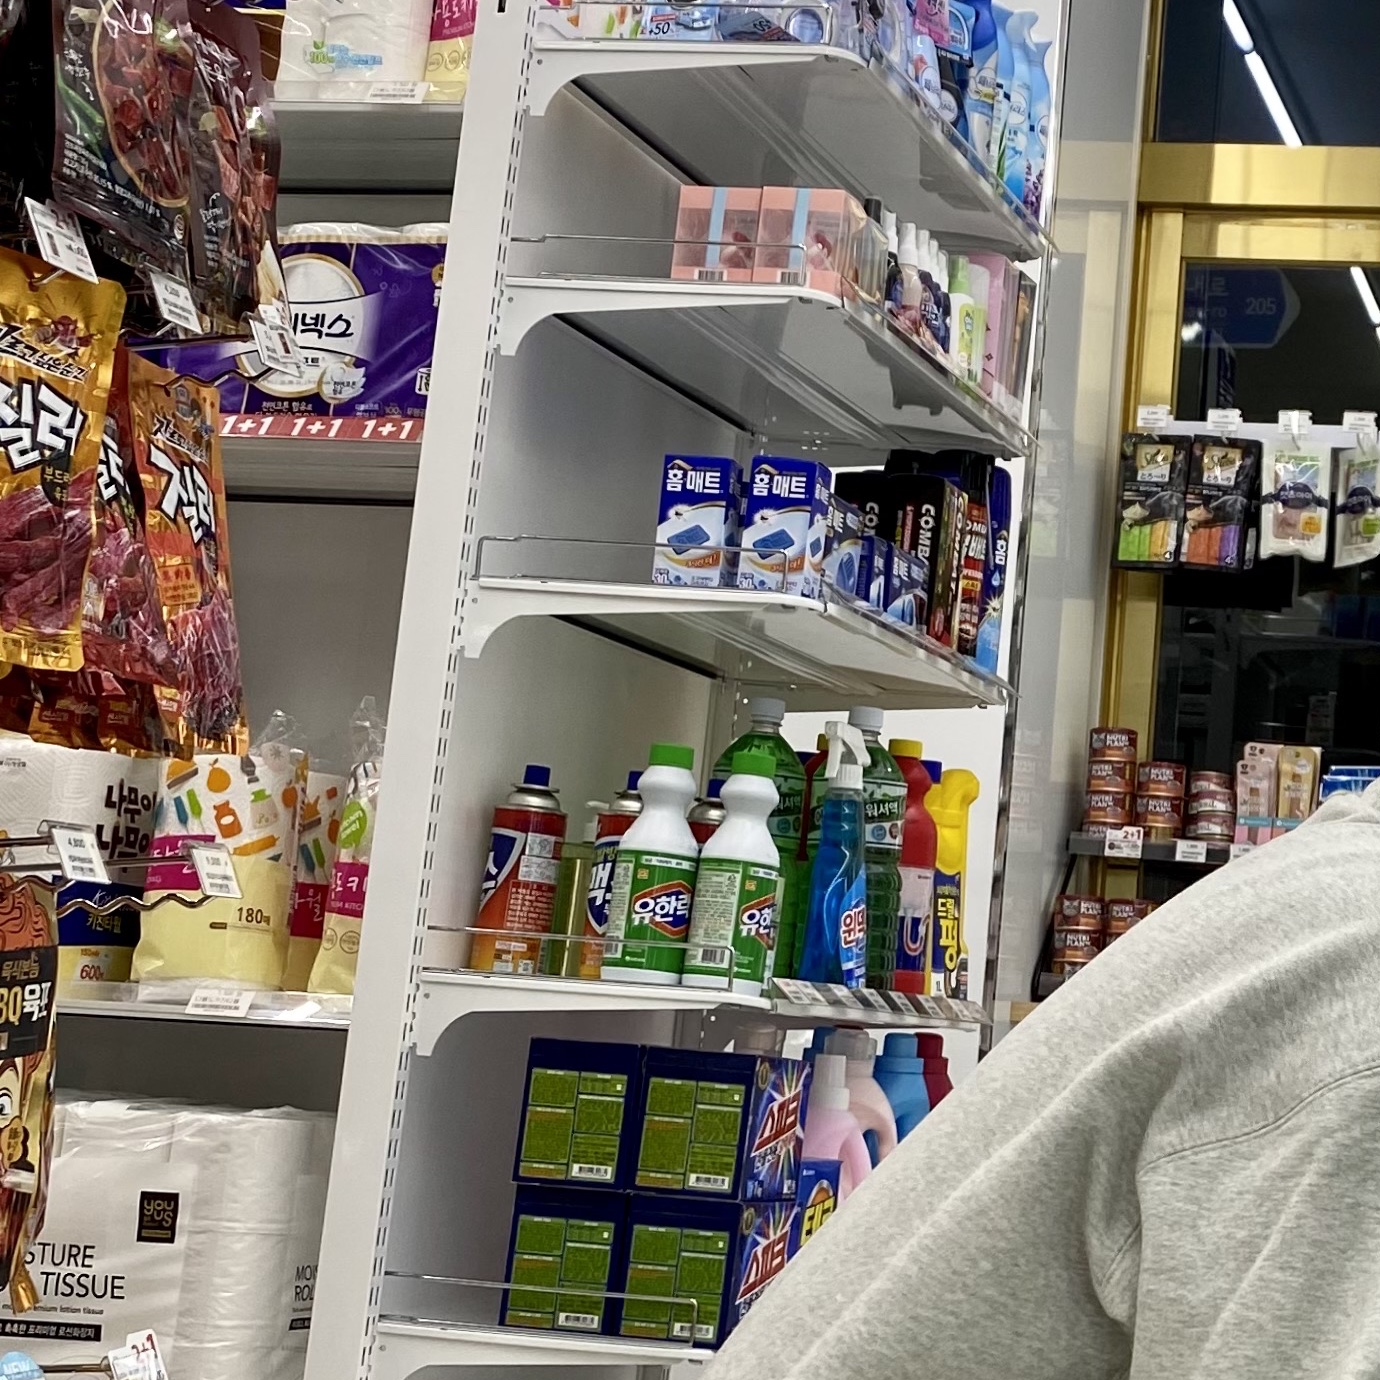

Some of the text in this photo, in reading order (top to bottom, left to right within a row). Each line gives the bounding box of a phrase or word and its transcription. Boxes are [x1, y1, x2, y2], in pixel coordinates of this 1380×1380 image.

[1245, 297, 1277, 315] 205
[221, 415, 274, 435] 1+1
[290, 417, 343, 438] 1+1
[361, 419, 413, 440] 1+1
[864, 801, 900, 818] 워셔액
[1122, 829, 1142, 840] 2+1
[40, 1271, 125, 1300] TISSUE
